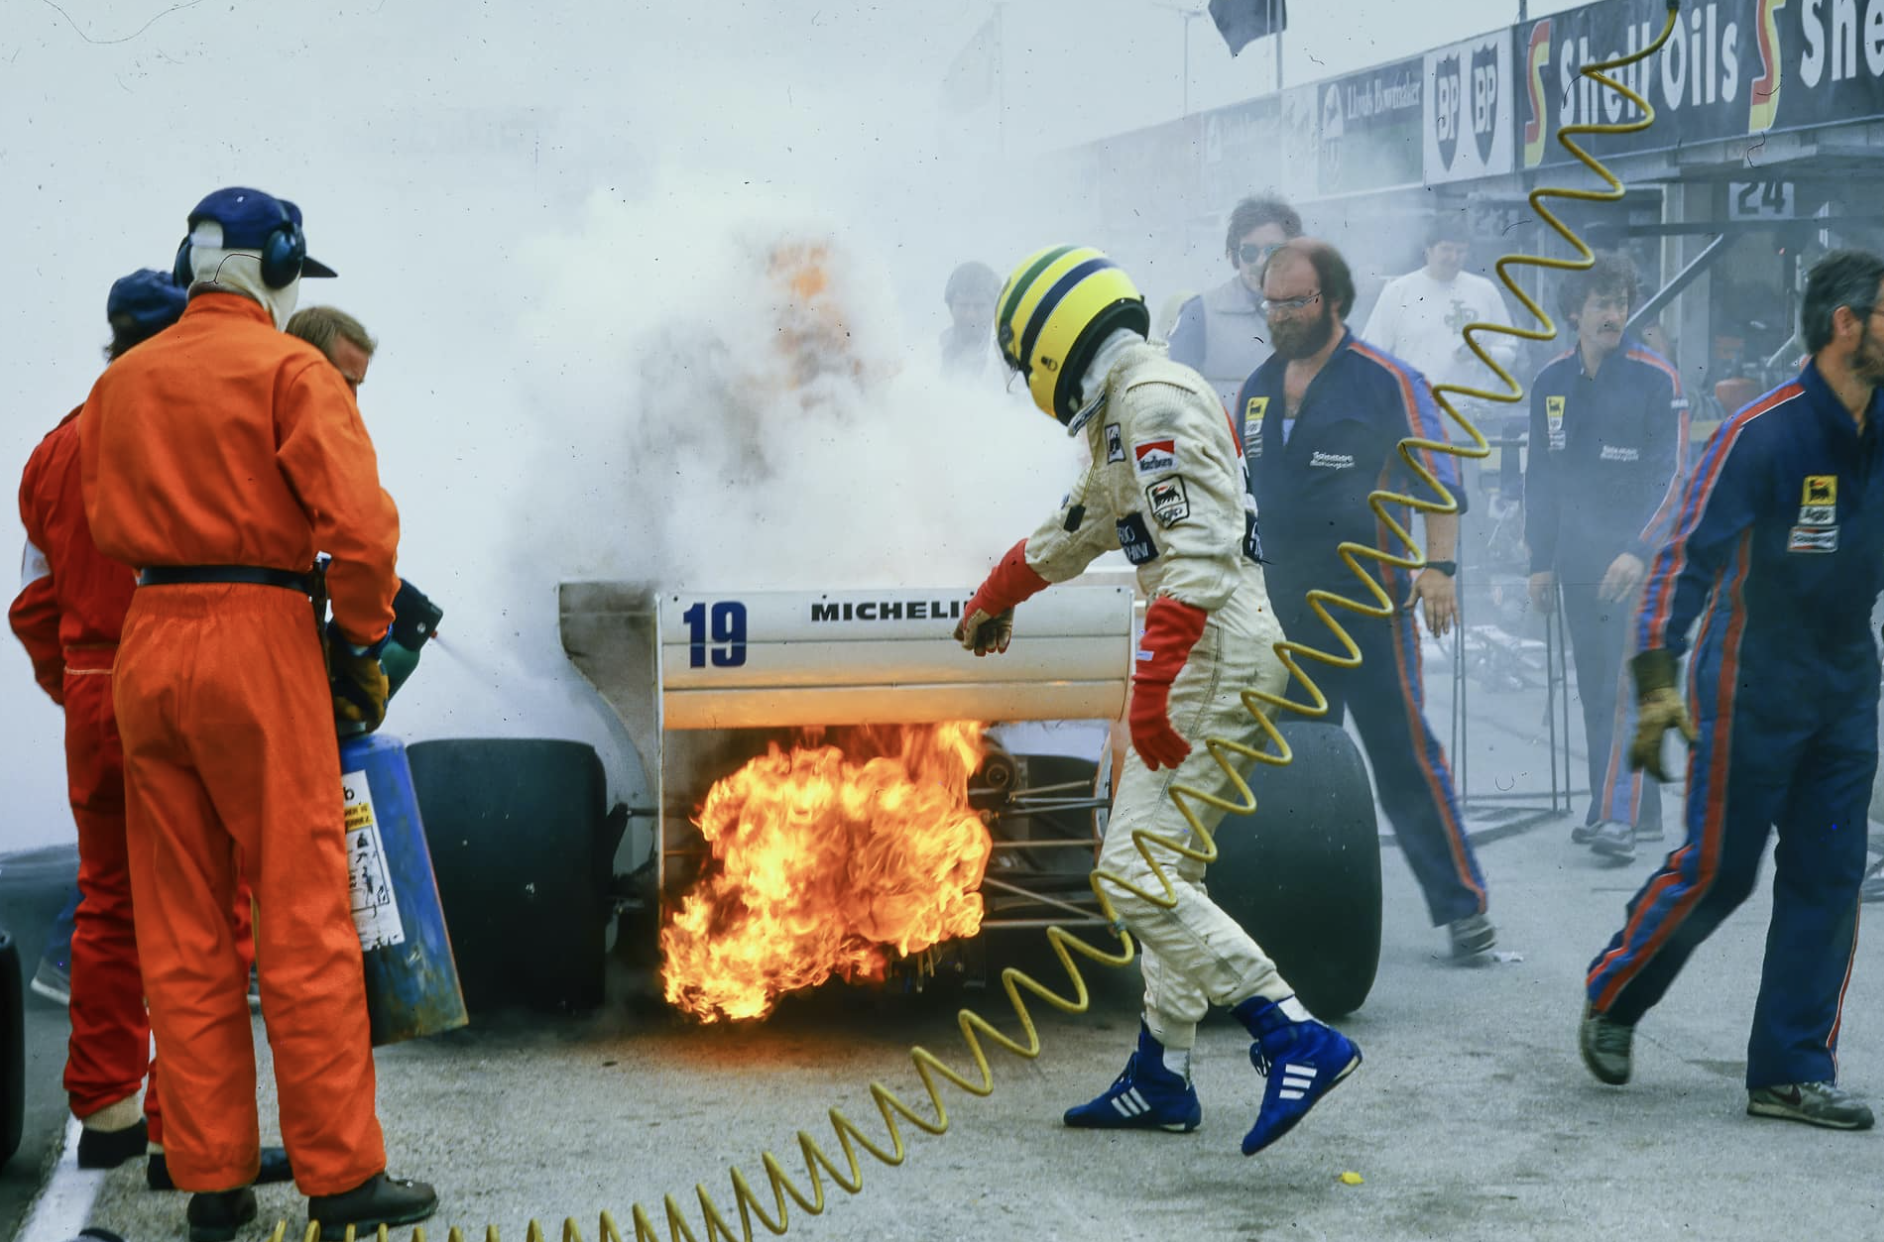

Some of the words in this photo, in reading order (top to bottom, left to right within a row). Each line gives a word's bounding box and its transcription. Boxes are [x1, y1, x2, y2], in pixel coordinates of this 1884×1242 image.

[1559, 22, 1650, 127] Shell
[1661, 3, 1738, 110] Oils
[1438, 74, 1459, 140] BP
[1474, 64, 1497, 134] BP
[1738, 178, 1785, 215] 24
[683, 601, 747, 668] 19
[811, 601, 967, 621] MICHELI
